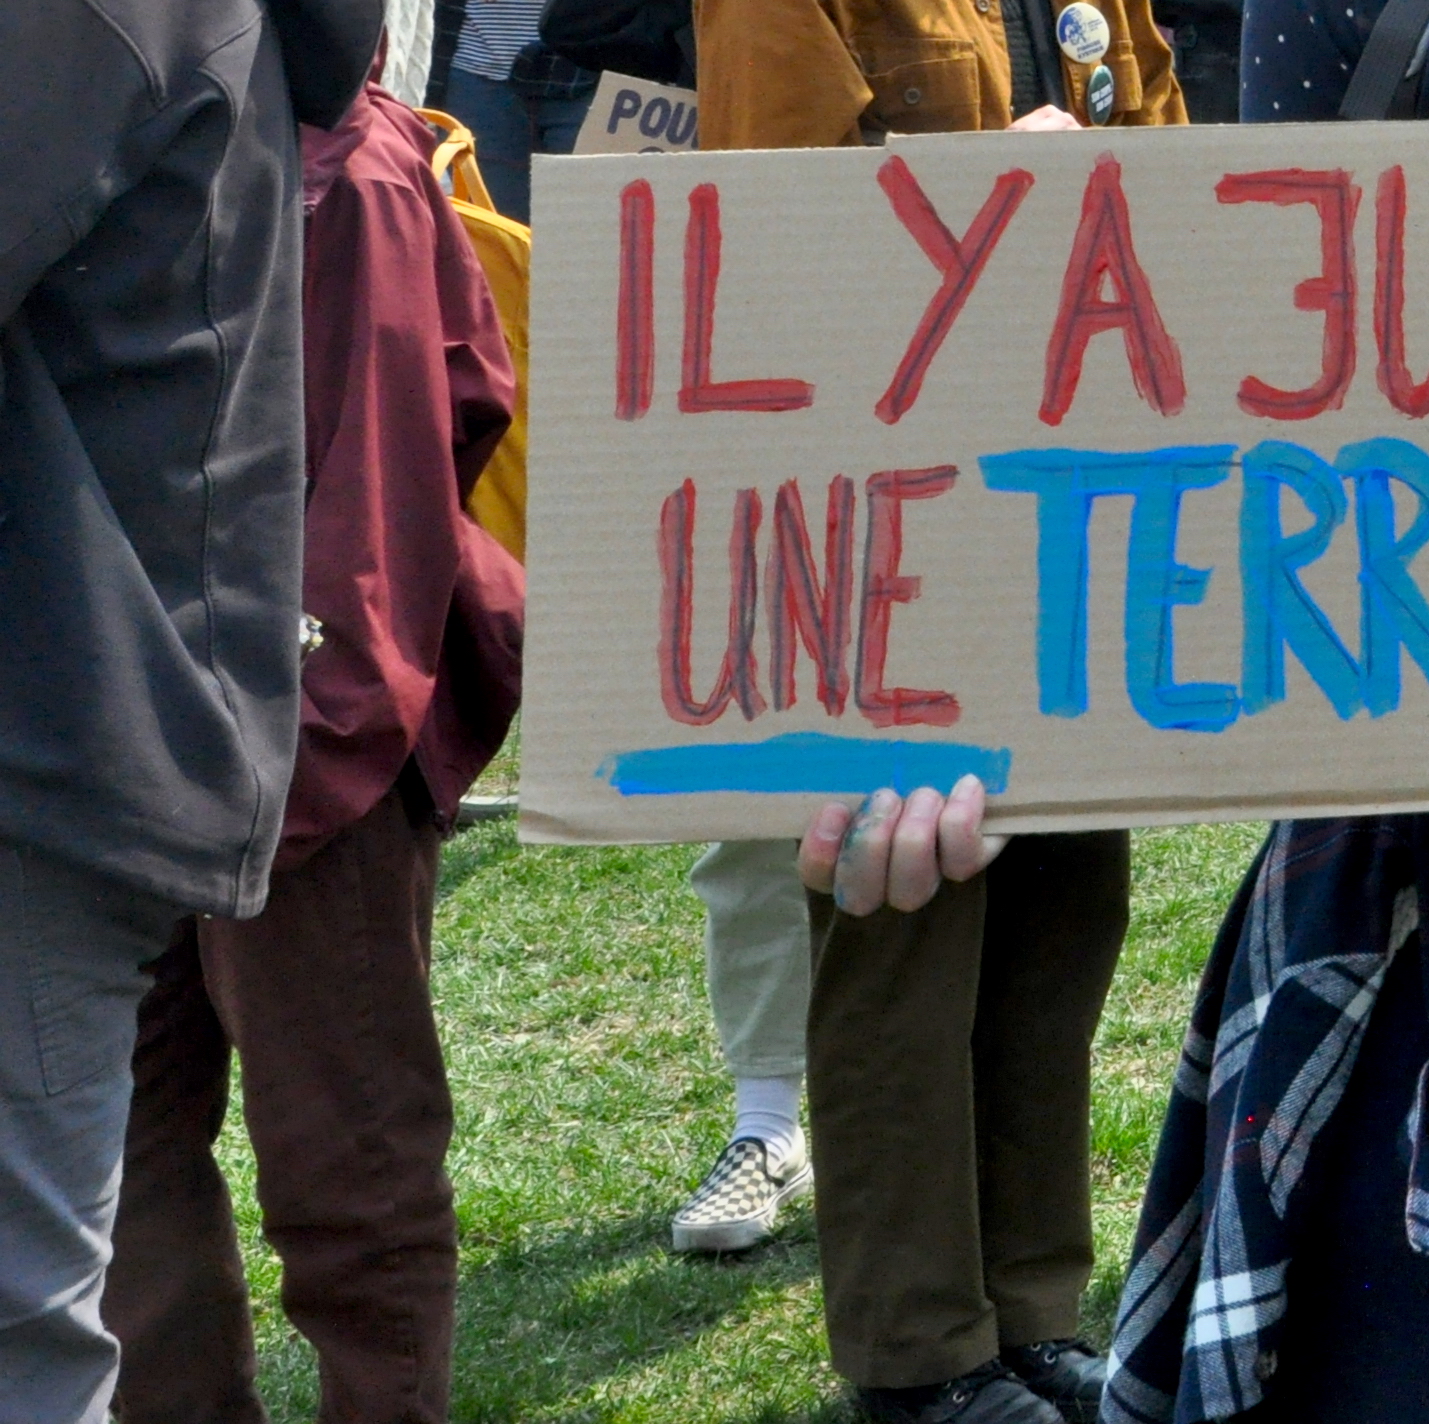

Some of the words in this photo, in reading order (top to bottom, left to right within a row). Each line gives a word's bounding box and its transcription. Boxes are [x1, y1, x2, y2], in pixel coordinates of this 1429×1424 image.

[606, 88, 699, 149] POU
[615, 177, 817, 423] IL
[655, 464, 963, 729] UNE
